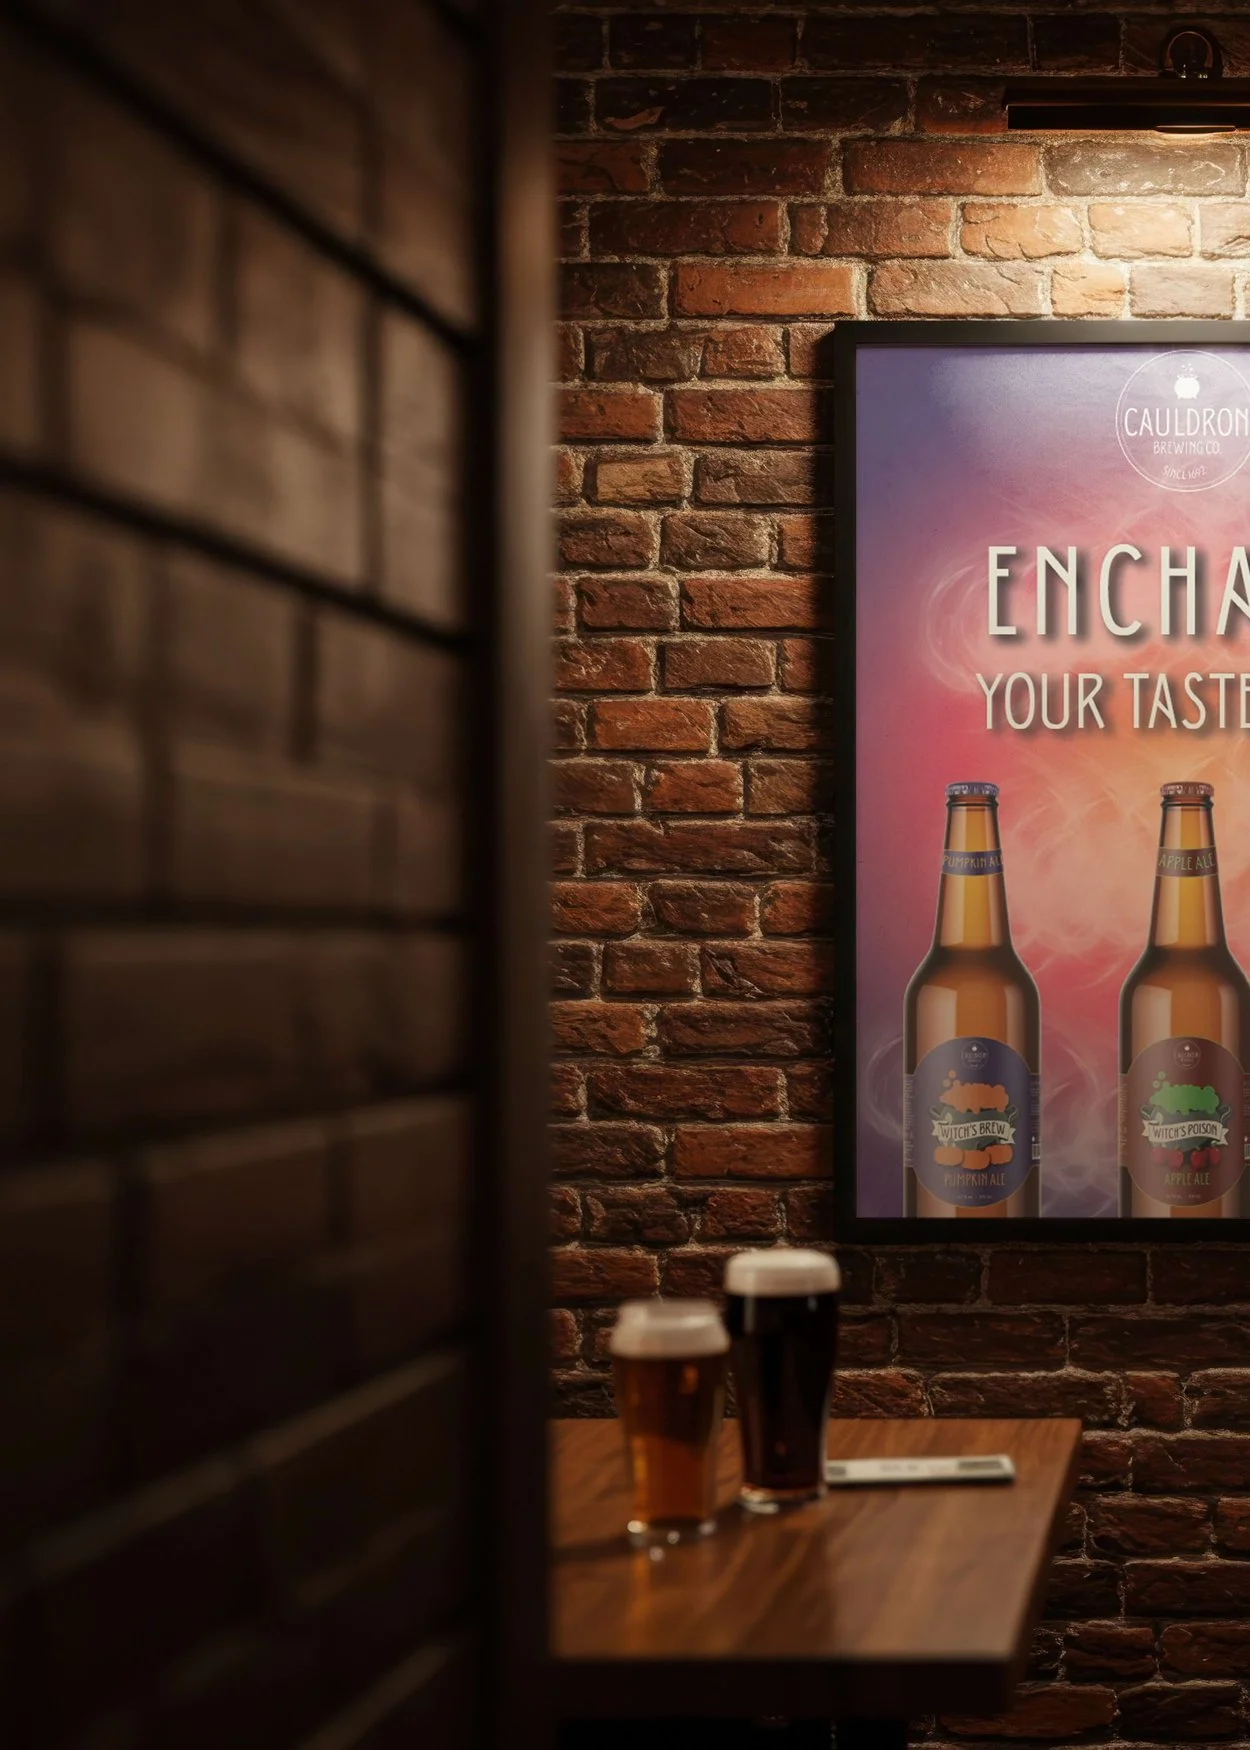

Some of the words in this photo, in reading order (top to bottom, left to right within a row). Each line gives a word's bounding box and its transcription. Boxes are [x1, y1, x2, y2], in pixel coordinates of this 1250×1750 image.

[1124, 408, 1249, 437] CAULDRON
[1153, 440, 1203, 455] BREWING
[975, 672, 1105, 730] YOUR
[943, 855, 987, 870] PUMPKIN
[1158, 853, 1193, 871] APPLE
[1195, 852, 1216, 870] ALE
[941, 1123, 978, 1139] WITCH'S
[980, 1121, 1006, 1135] BREW
[1153, 1126, 1187, 1139] WITCH'S
[1188, 1122, 1218, 1136] POISON
[944, 1172, 988, 1187] PUMPKIN
[989, 1172, 1006, 1186] ALE
[1165, 1172, 1192, 1186] APPLE
[1194, 1172, 1211, 1186] ALE
